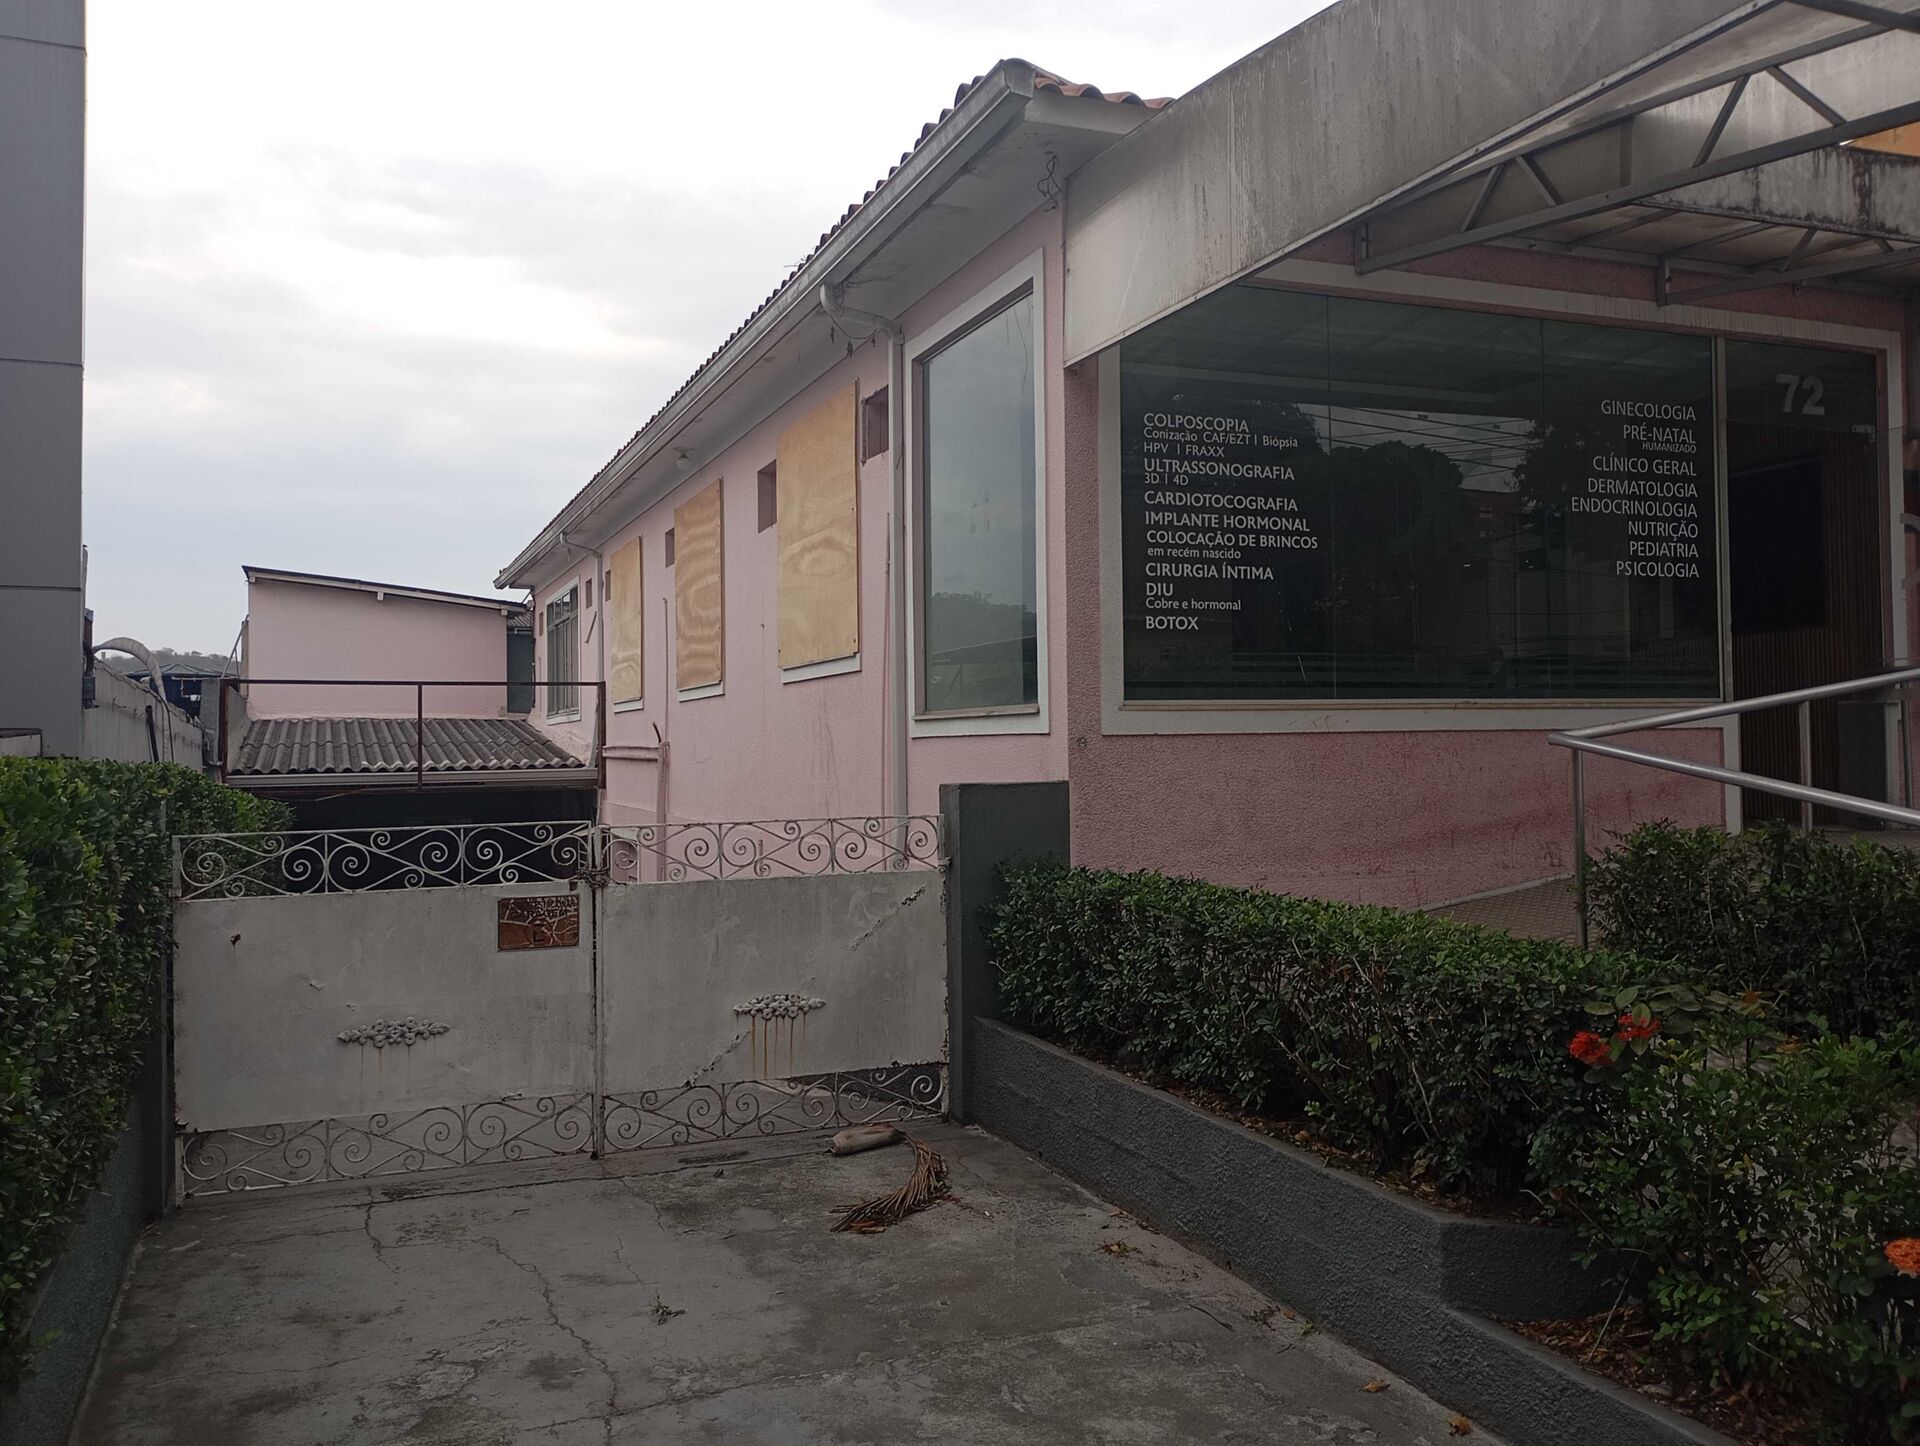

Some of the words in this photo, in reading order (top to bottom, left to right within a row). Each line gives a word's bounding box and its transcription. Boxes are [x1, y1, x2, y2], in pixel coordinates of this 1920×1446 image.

[1776, 373, 1825, 416] 72
[1601, 399, 1696, 421] GINECOLOGIA
[1144, 413, 1249, 433] COLPOSCOPIA
[1623, 422, 1696, 443] PRÉ-NATAL
[1144, 427, 1198, 442] Conização
[1203, 431, 1251, 445] CAF/EZT
[1262, 435, 1298, 450] Biópsia
[1642, 442, 1696, 454] HUMANIZADO
[1144, 442, 1169, 453] HPV
[1185, 444, 1225, 457] FRAXX
[1144, 458, 1295, 480] ULTRASSONOGRAFIA
[1593, 452, 1648, 473] CLÍNICO
[1653, 459, 1696, 476] GERAL
[1144, 473, 1160, 484] 3D
[1173, 475, 1188, 486] 4D
[1588, 478, 1698, 498] DERMATOLOGIA
[1144, 491, 1298, 511] CARDIOTOCOGRAFIA
[1571, 497, 1697, 517] ENDOCRINOLOGIA
[1145, 511, 1219, 527] IMPLANTE
[1224, 515, 1310, 532] HORMONAL
[1628, 520, 1698, 541] NUTRIÇÃO
[1147, 530, 1235, 548] COLOCAÇÃO
[1239, 534, 1256, 547] DE
[1260, 535, 1318, 549] BRINCOS
[1630, 540, 1698, 558] PEDIATRIA
[1147, 548, 1164, 556] em
[1168, 547, 1200, 558] recém
[1203, 548, 1241, 559] nascido
[1146, 562, 1218, 578] CIRURGIA
[1223, 562, 1274, 580] ÍNTIMA
[1617, 561, 1699, 578] PSICOLOGIA
[1146, 583, 1173, 596] DIU
[1146, 598, 1179, 609] Cobre
[1182, 601, 1188, 609] e
[1191, 599, 1241, 610] hormonal
[1146, 616, 1199, 630] BOTOX
